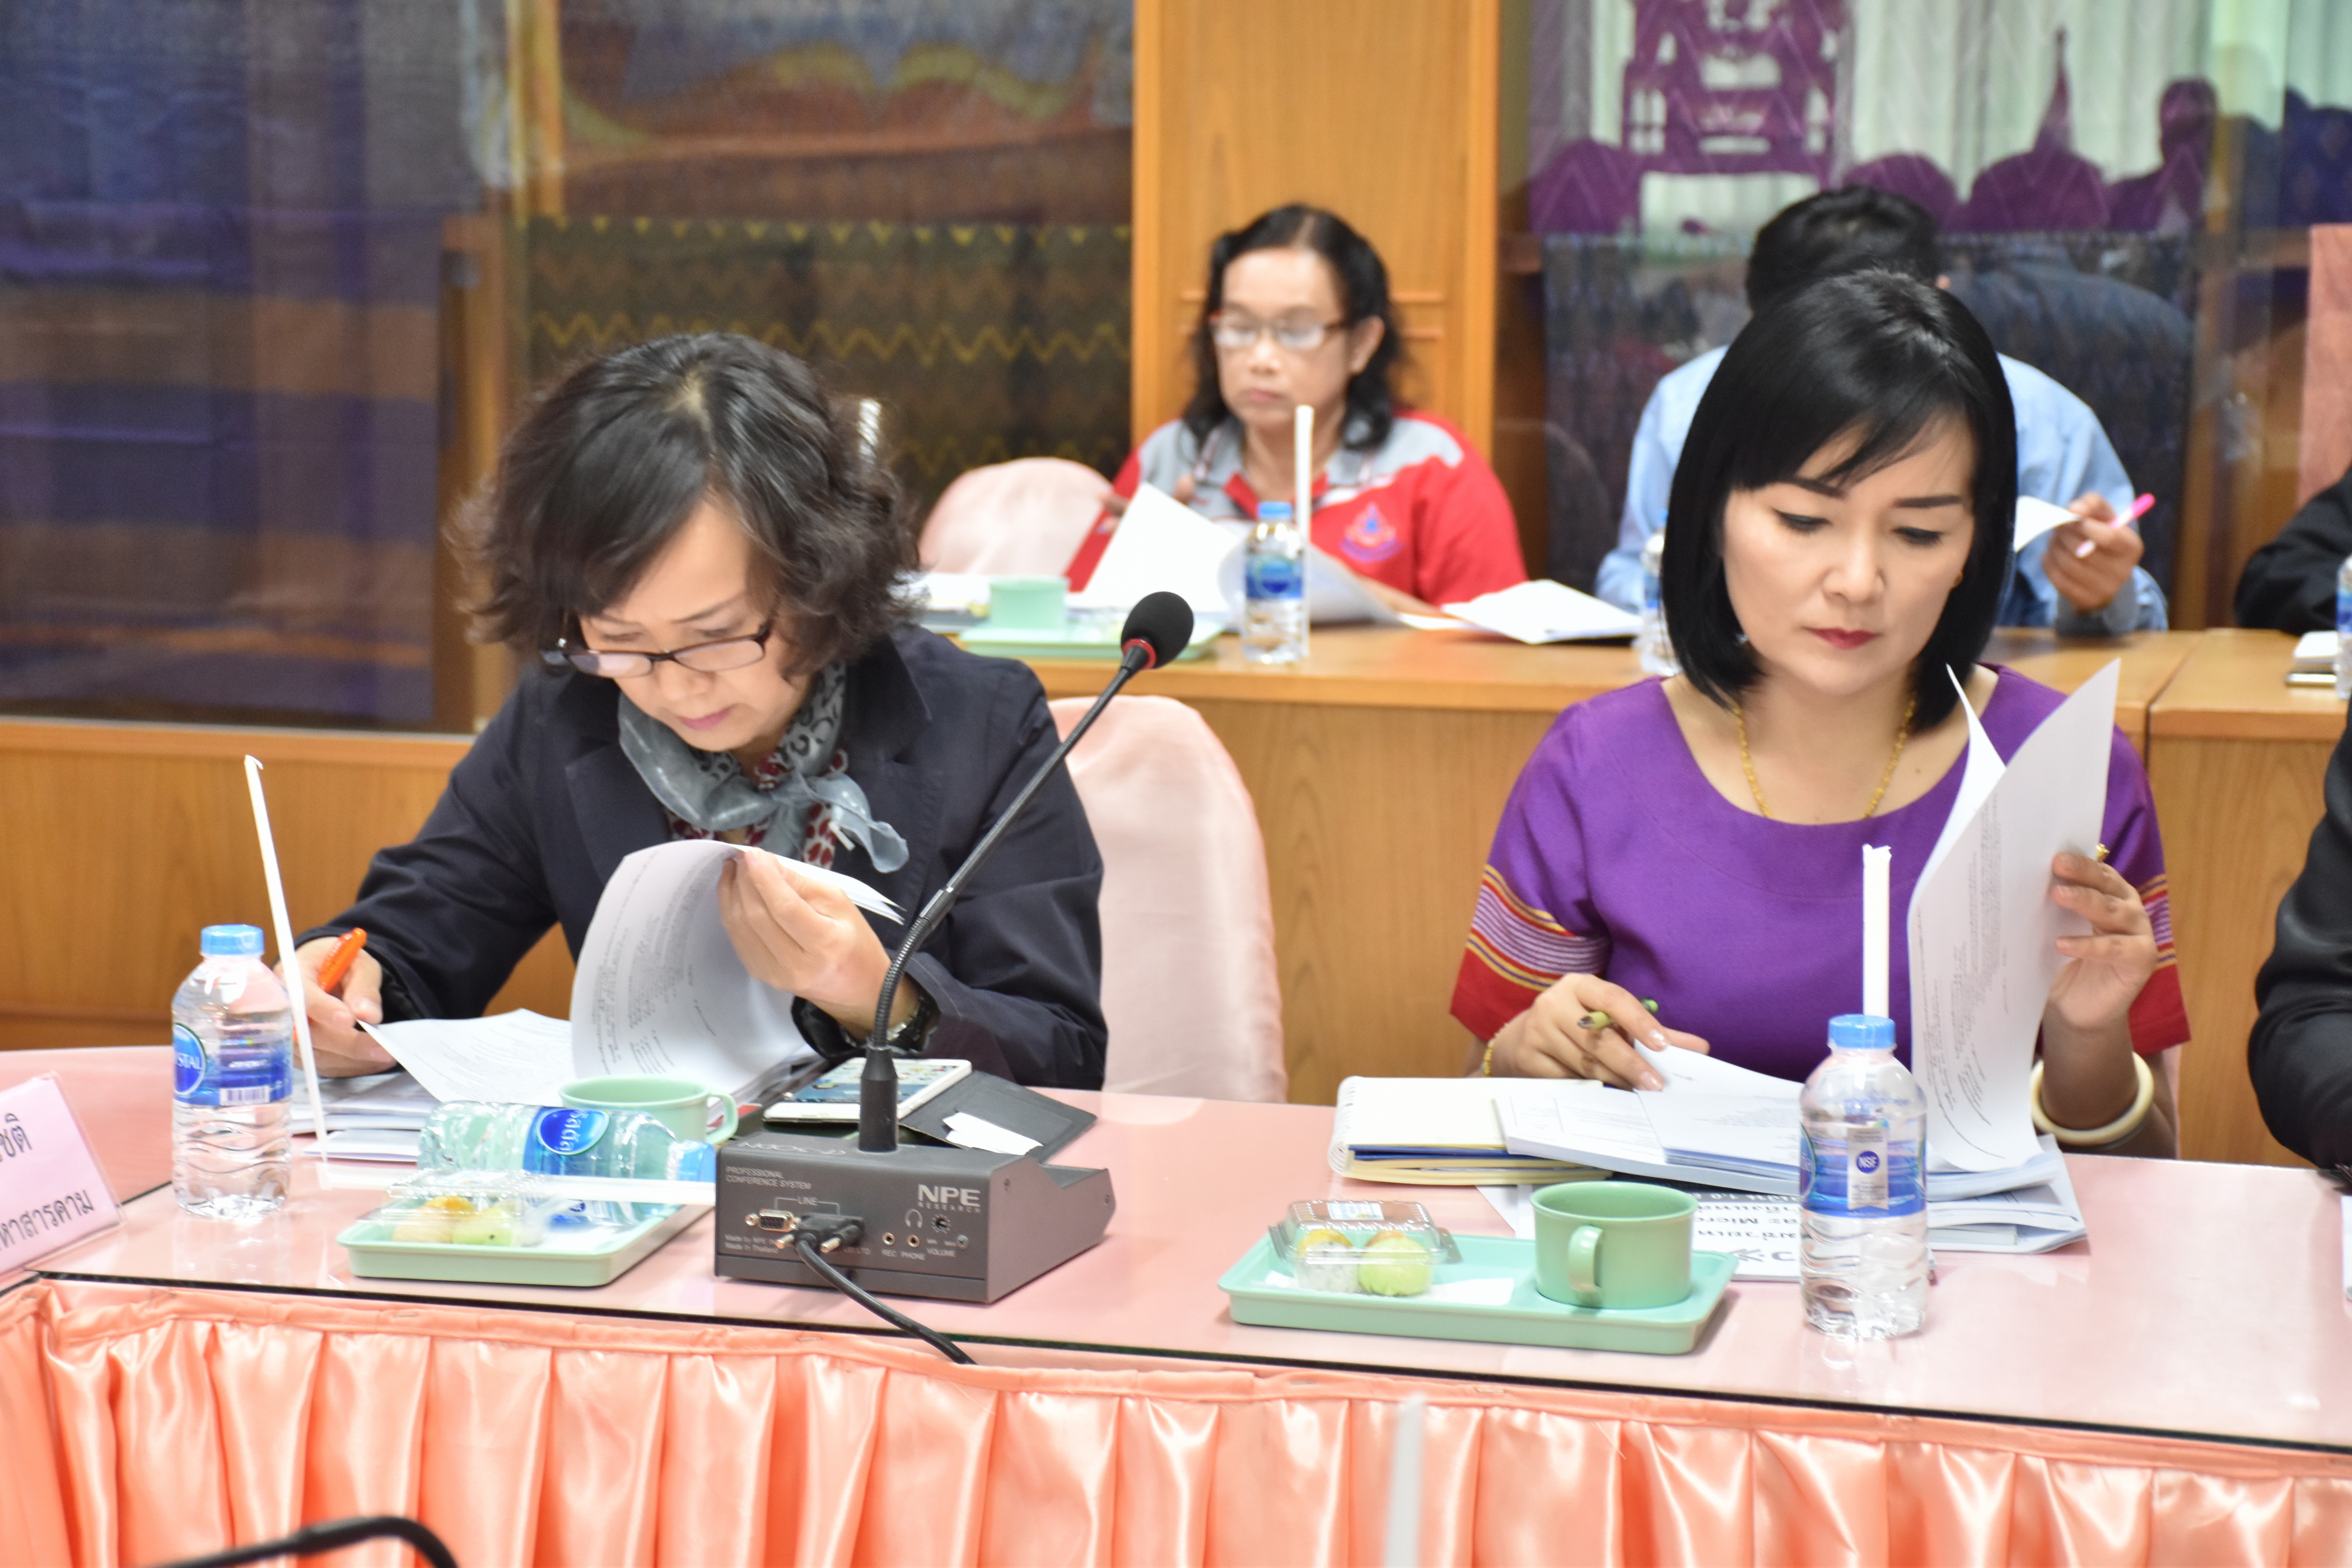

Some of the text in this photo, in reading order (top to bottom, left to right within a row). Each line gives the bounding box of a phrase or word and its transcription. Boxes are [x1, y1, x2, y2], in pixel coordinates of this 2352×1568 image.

[1859, 1156, 1878, 1168] NSF
[725, 1165, 784, 1179] PROFESSIONAL
[725, 1174, 811, 1189] CONFERENCE SYSTEM
[797, 1196, 818, 1206] LINE
[918, 1184, 981, 1207] NPE
[918, 1201, 981, 1214] RESEARCH
[881, 1249, 897, 1257] REC
[900, 1251, 926, 1260] PHONE
[926, 1248, 956, 1257] VOLUME
